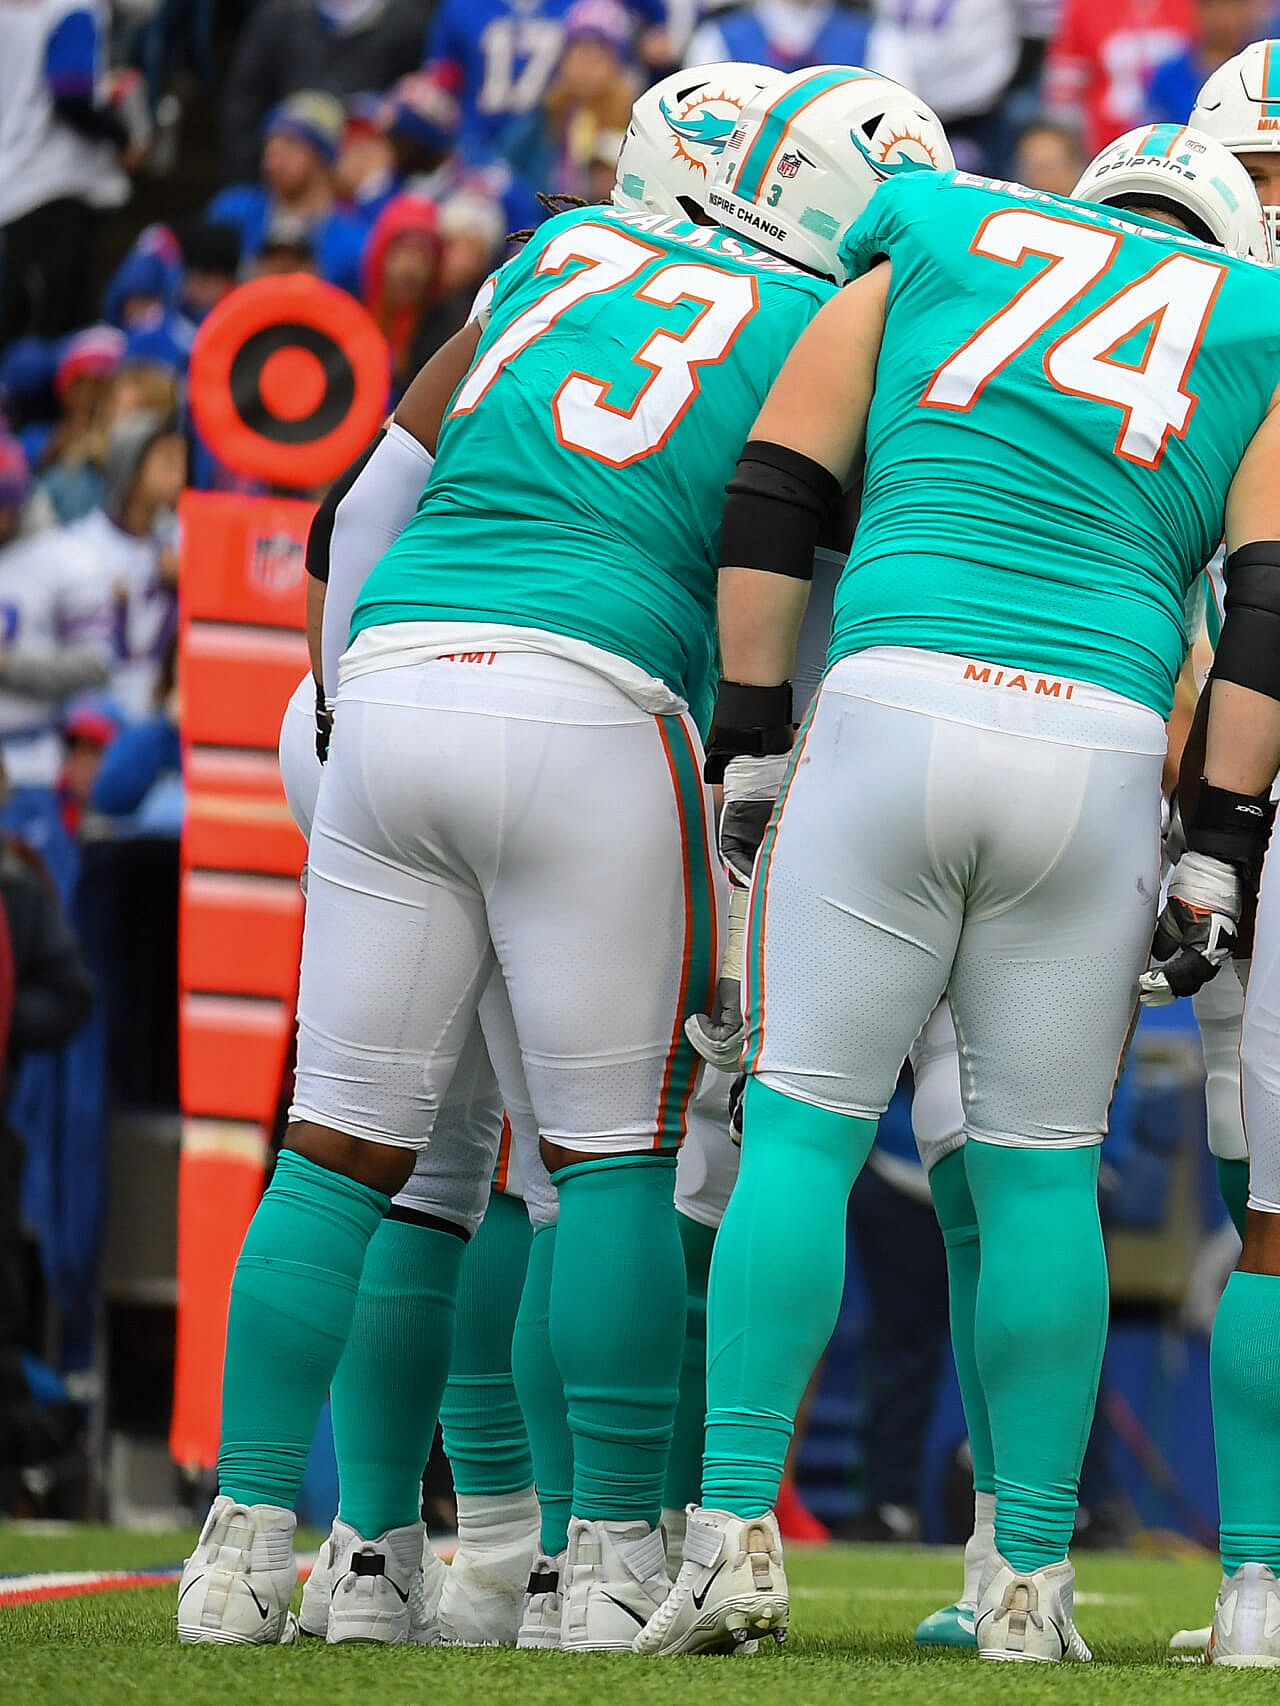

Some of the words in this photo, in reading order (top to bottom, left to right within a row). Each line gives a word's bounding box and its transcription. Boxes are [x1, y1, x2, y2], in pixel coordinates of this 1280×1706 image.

[767, 184, 782, 207] 3
[737, 207, 788, 242] CHANGE
[448, 221, 760, 470] 73
[916, 207, 1230, 470] 74
[963, 664, 1074, 700] MIAMI
